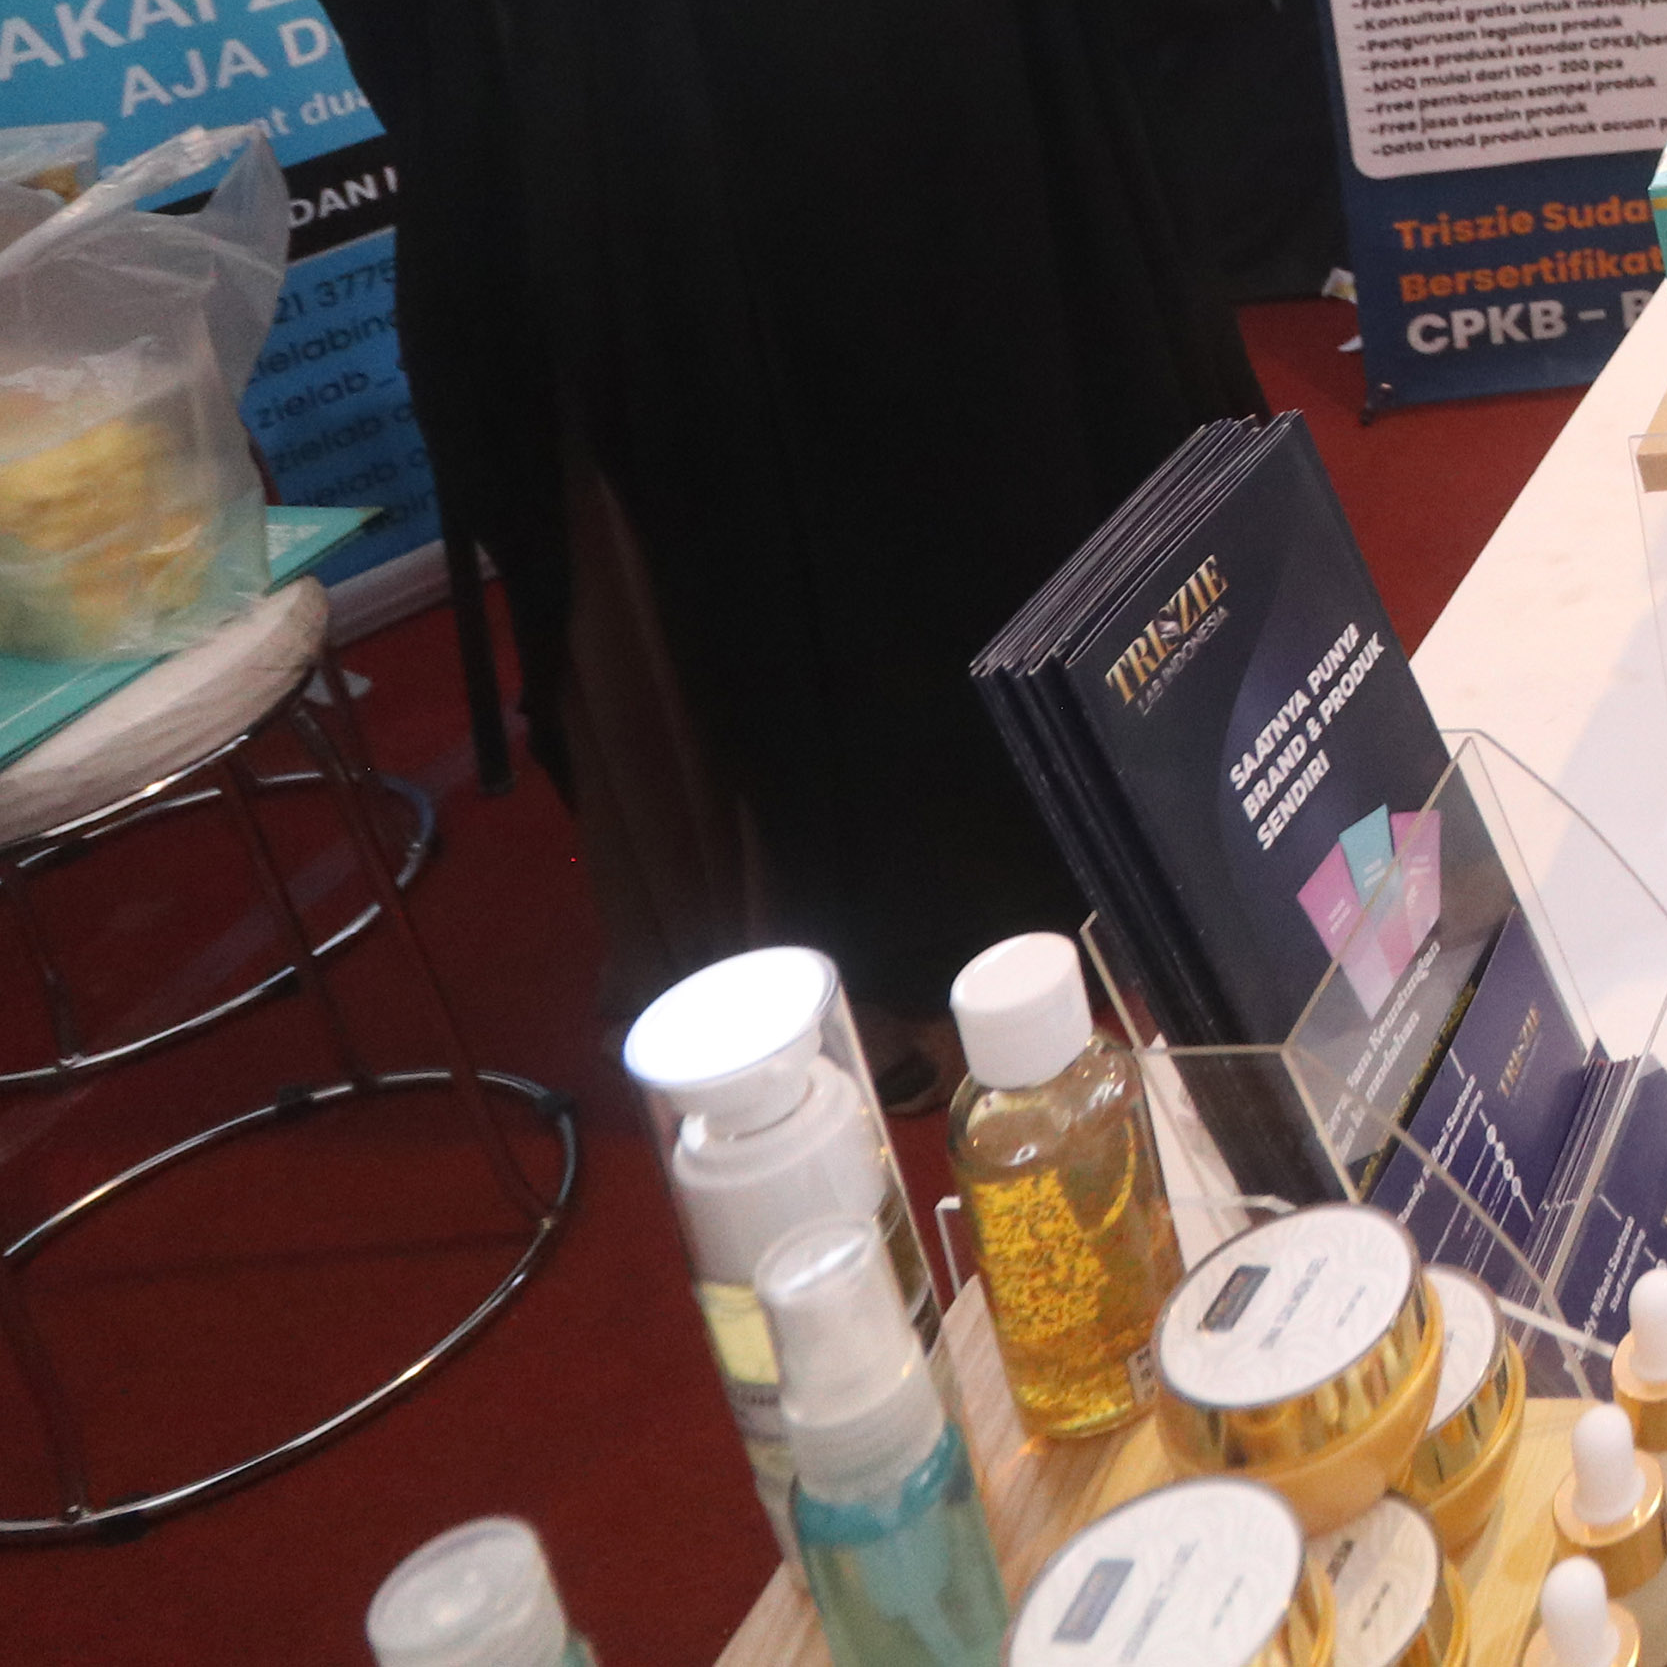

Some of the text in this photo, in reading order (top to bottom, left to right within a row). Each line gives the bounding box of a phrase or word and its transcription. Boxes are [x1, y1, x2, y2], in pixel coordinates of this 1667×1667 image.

[1465, 3, 1516, 24] gratis
[1561, 15, 1622, 31] produk
[1420, 69, 1471, 87] mulai
[1474, 67, 1511, 82] dari
[1514, 64, 1543, 77] 100
[1593, 58, 1623, 75] pcs
[1517, 39, 1585, 58] standar
[121, 38, 270, 118] AJA
[1418, 87, 1523, 111] pembuatan
[1527, 81, 1591, 99] sampel
[1595, 75, 1656, 95] produk
[1420, 116, 1459, 134] jasa
[1461, 108, 1521, 126] desain
[1525, 101, 1587, 123] produk
[1428, 134, 1476, 151] trend
[1479, 128, 1543, 150] produk
[1546, 119, 1597, 138] untuk
[1601, 118, 1655, 133] acuan
[1394, 192, 1653, 252] Triszie Suda
[1402, 243, 1665, 301] Bersertifikat
[1406, 300, 1567, 354] CPKB
[1104, 554, 1229, 705] TRISZIE
[1230, 623, 1361, 791] SAATNYA PUNYA
[1241, 632, 1386, 823] BRAND & PRODUK
[1257, 749, 1331, 851] SENDIRI
